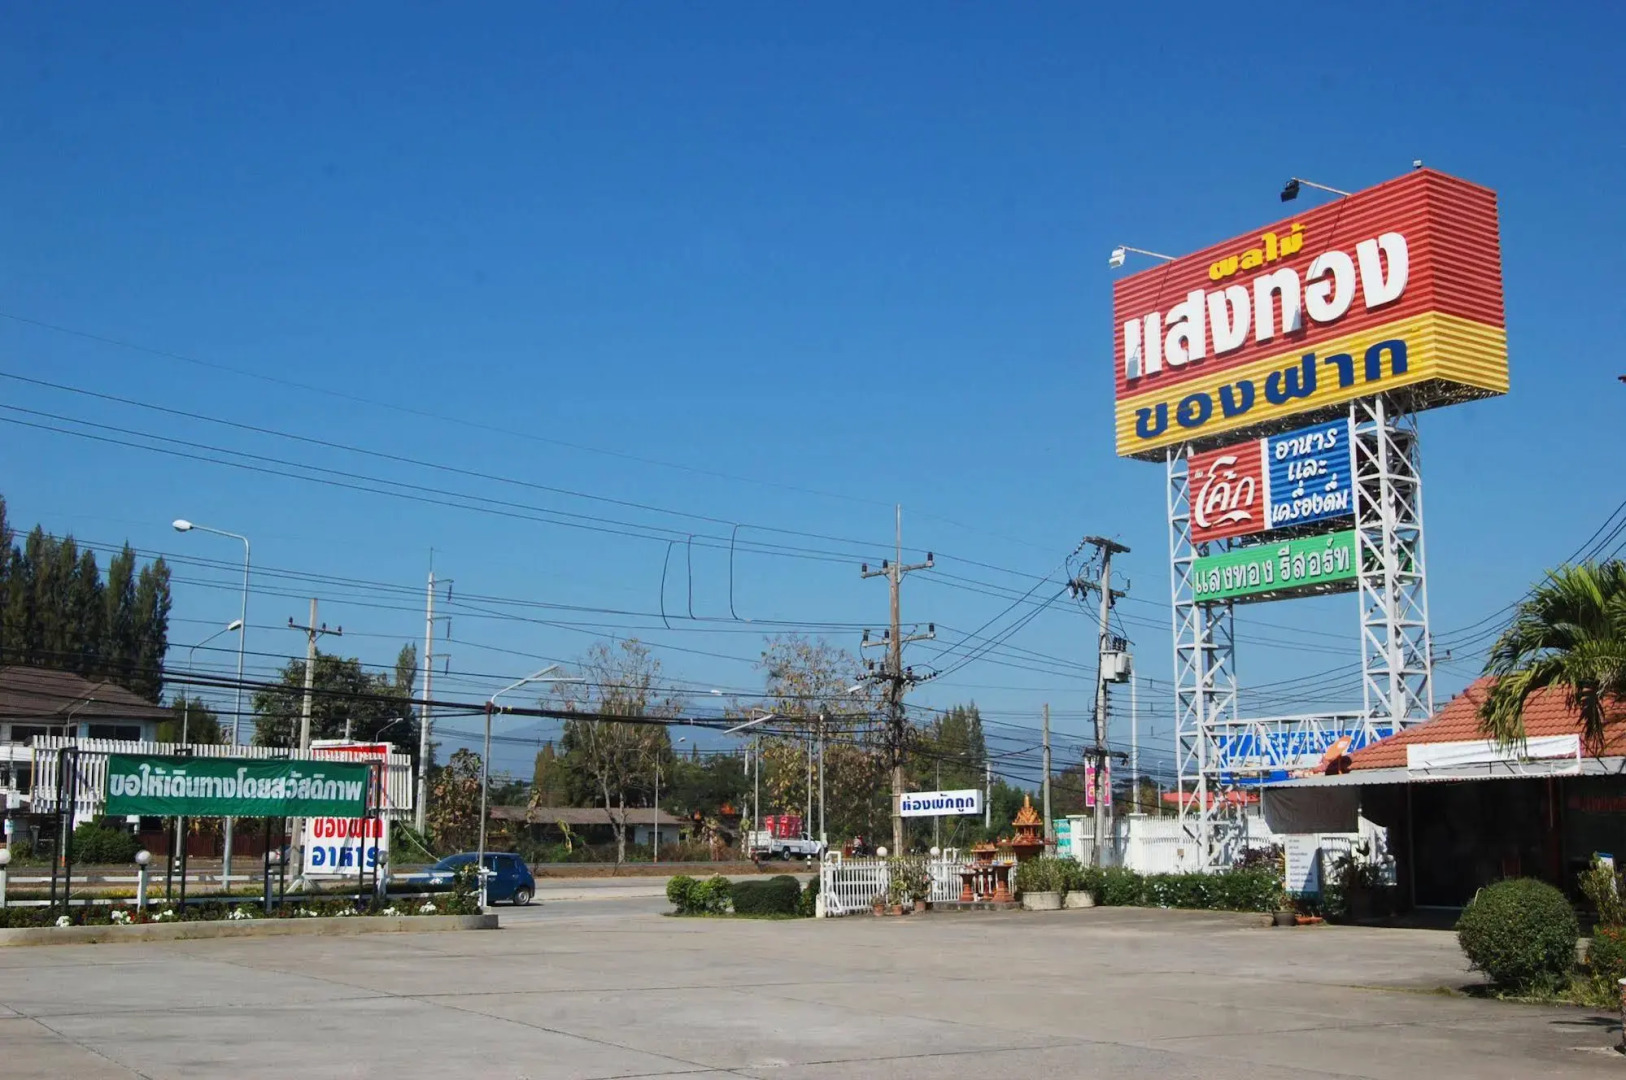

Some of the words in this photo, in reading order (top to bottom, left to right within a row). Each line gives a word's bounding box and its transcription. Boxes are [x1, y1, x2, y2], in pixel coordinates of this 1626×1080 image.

[1209, 222, 1307, 281] ผลไม้
[1124, 231, 1409, 380] แสงทอง
[1135, 339, 1409, 439] ของฝาก
[1275, 428, 1338, 460] อาหาร
[1288, 459, 1328, 481] และ
[1195, 456, 1255, 528] โค้ก
[1272, 473, 1348, 522] เครื่องดื่ม
[1196, 558, 1274, 594] แสงทอง
[1278, 538, 1350, 581] รีสอร์ท
[110, 763, 363, 801] ขอให้เดินทางโดยสวัสดิภาพ
